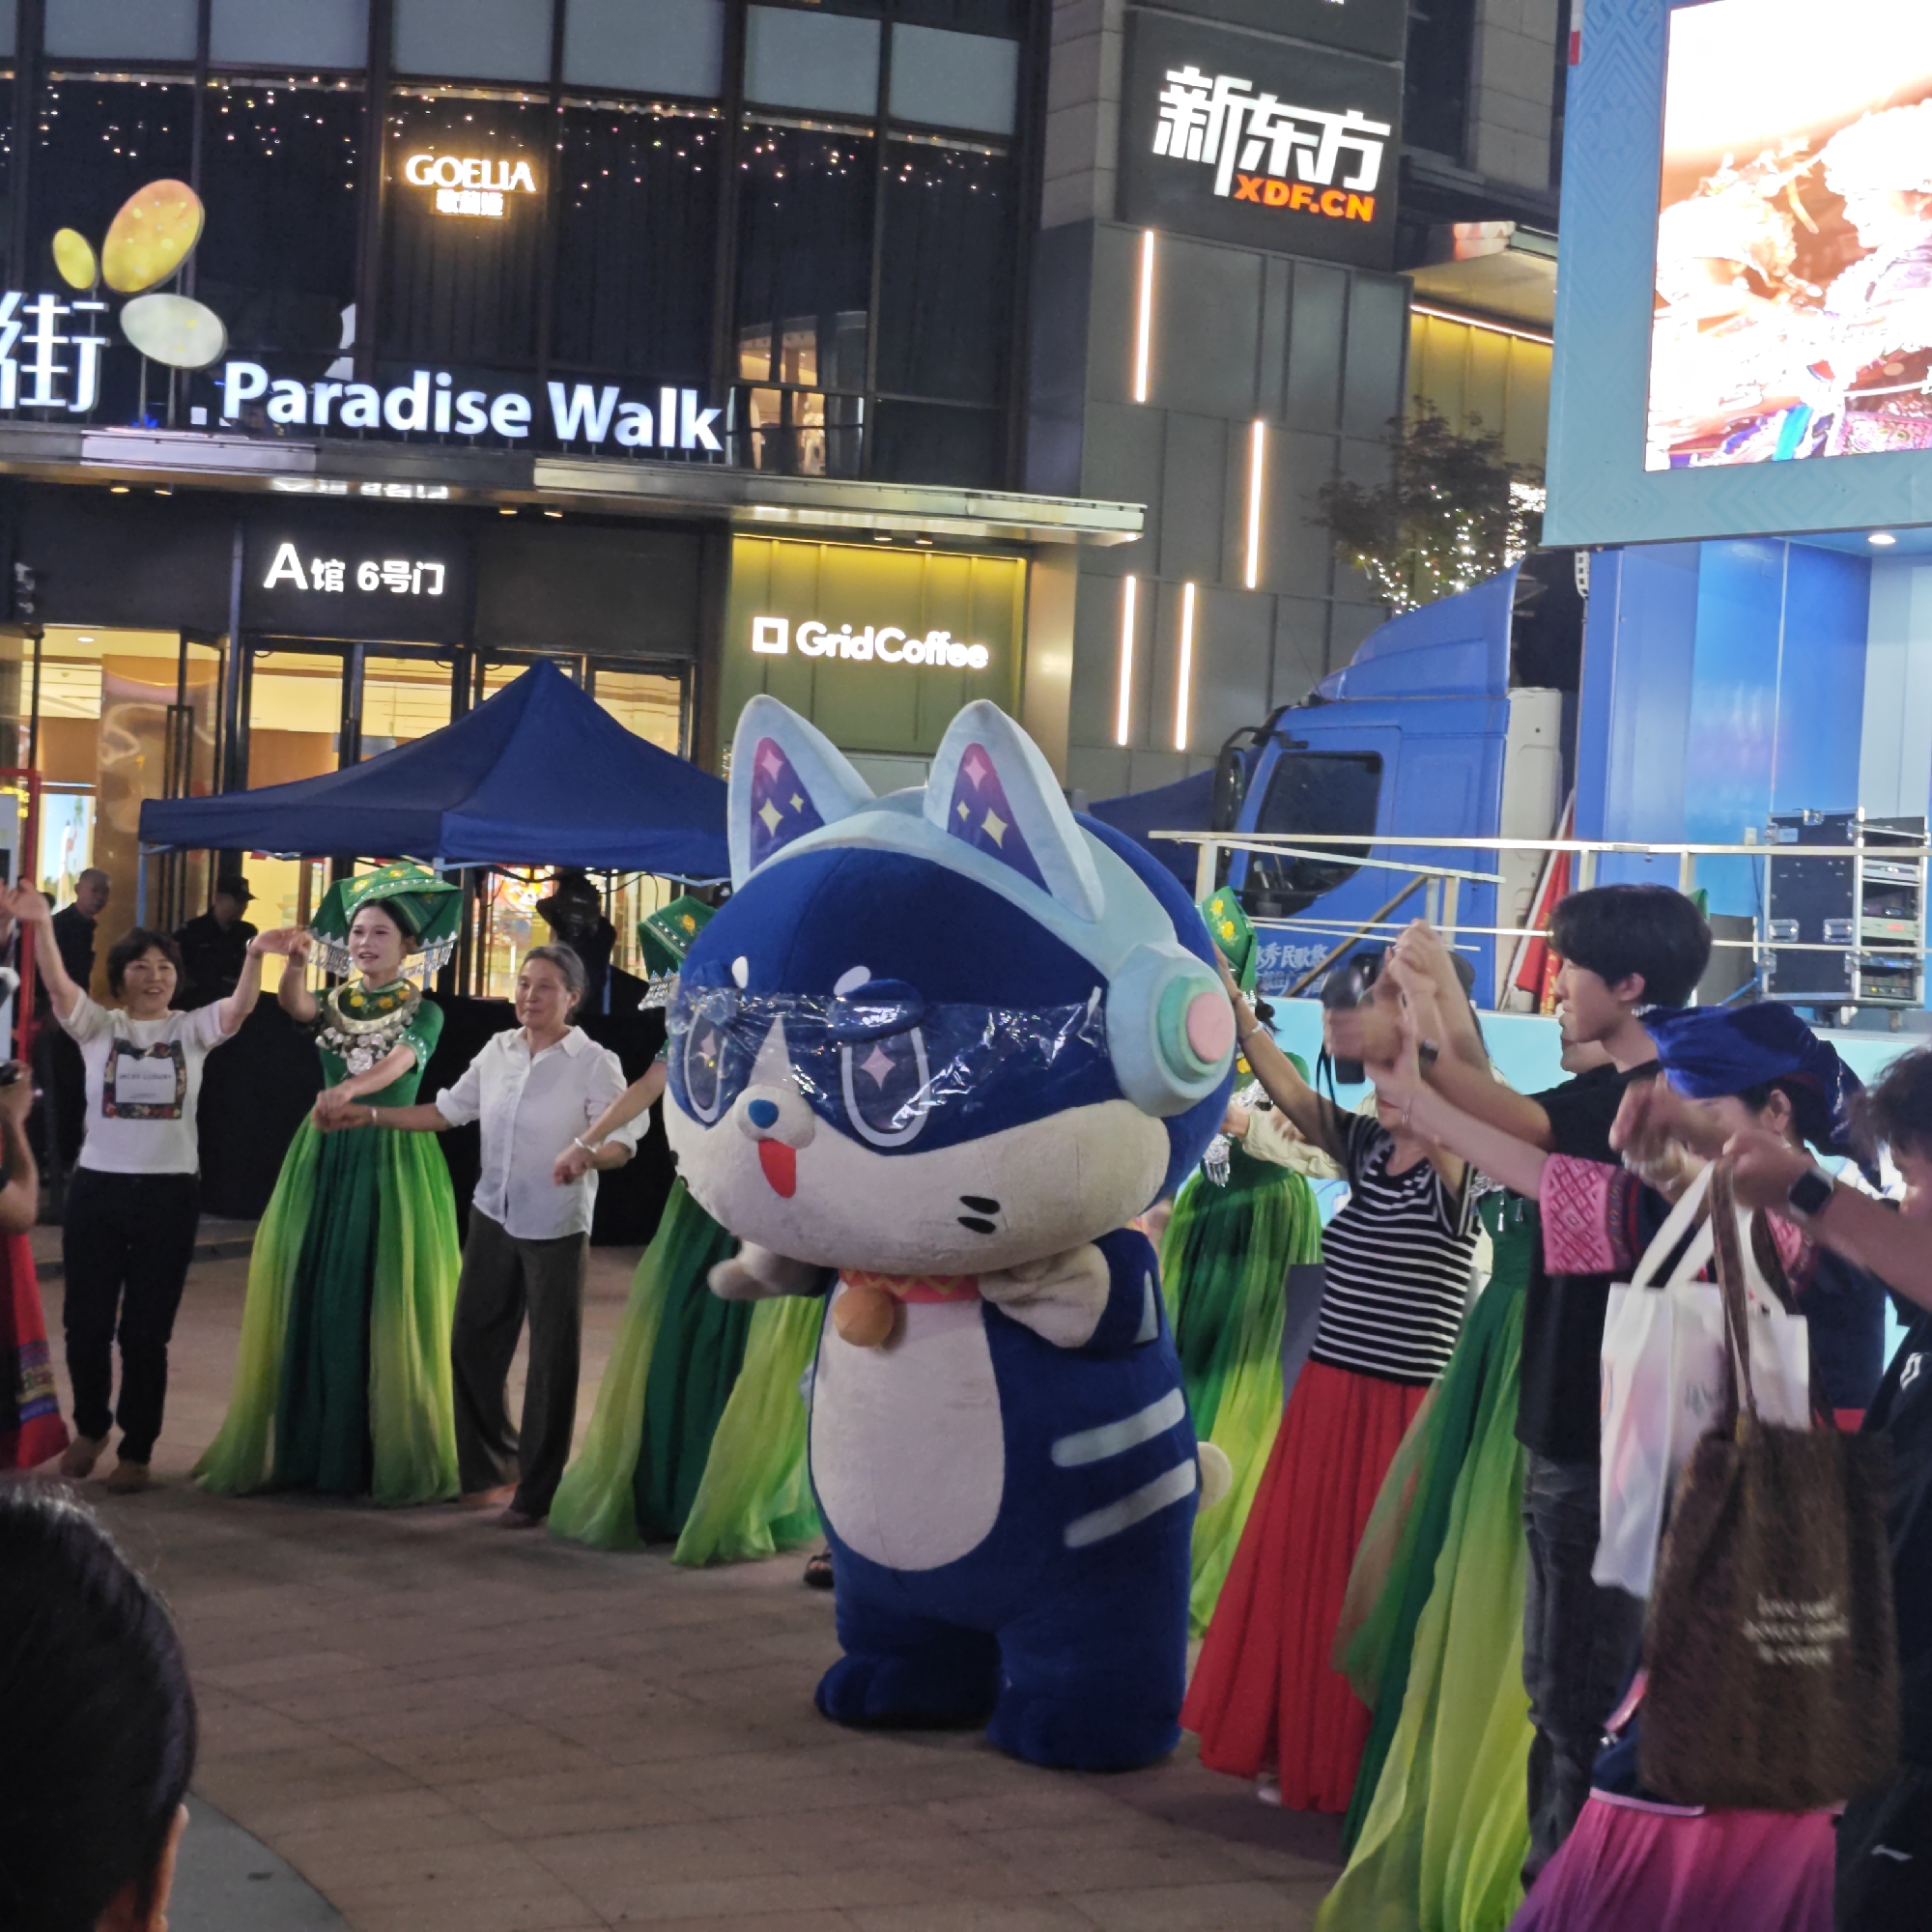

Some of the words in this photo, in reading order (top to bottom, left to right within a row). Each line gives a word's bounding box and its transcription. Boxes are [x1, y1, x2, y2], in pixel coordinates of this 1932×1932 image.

[1152, 66, 1392, 197] 新东方
[406, 155, 536, 191] GOELIA
[1234, 174, 1376, 223] XDF.CN
[0, 292, 107, 412] 街
[222, 361, 530, 438] Paradise
[547, 381, 724, 451] Walk
[264, 543, 346, 592] A馆
[356, 559, 445, 595] 6号门
[796, 621, 989, 668] GridCoffee
